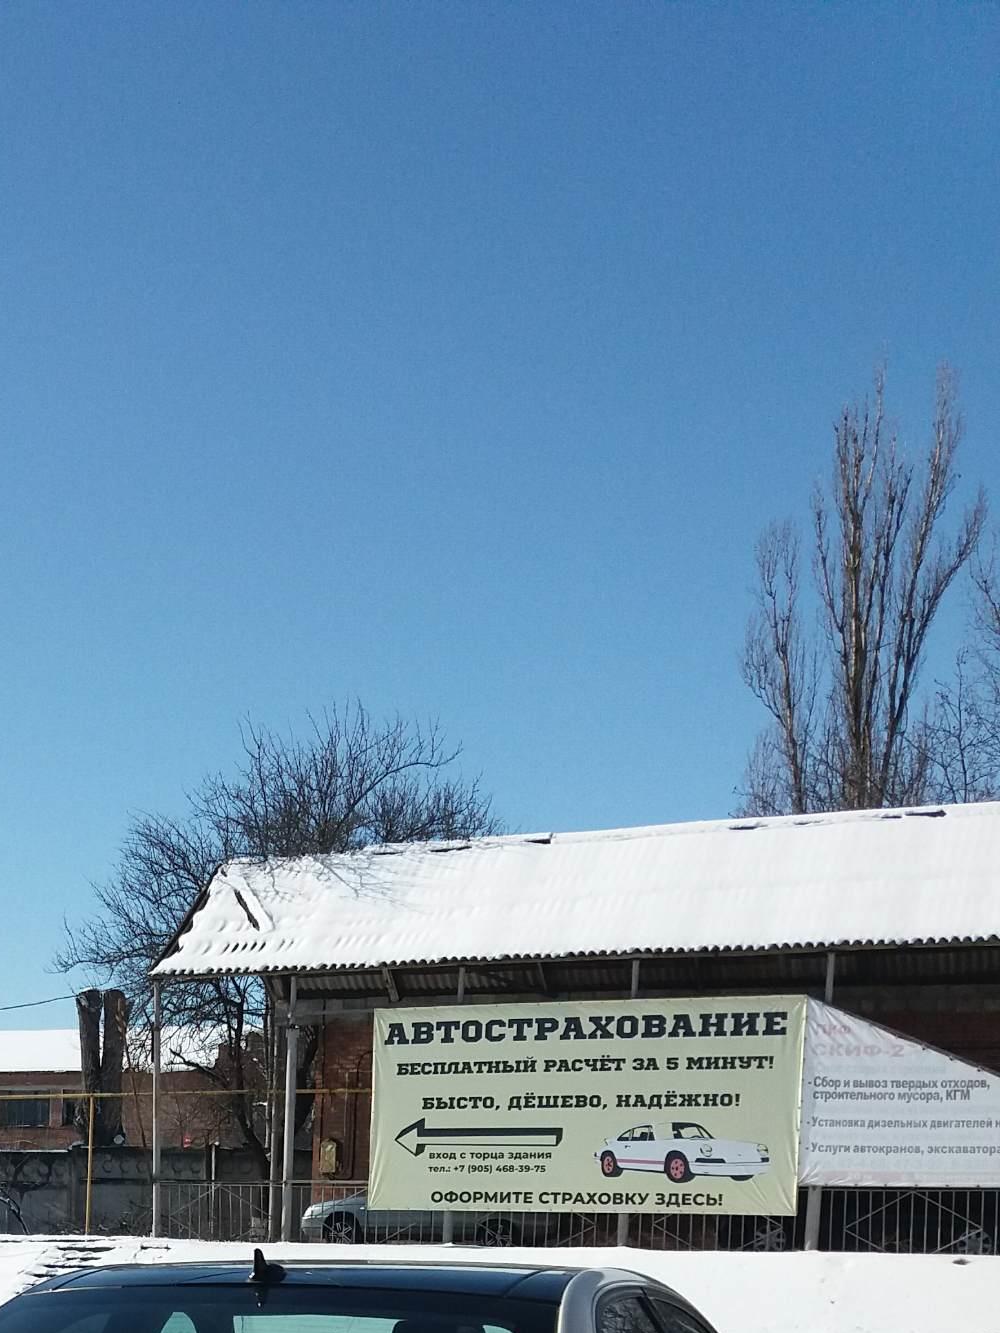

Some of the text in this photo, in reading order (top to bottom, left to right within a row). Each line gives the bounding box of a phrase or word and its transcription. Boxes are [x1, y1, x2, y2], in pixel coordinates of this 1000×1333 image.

[384, 1011, 788, 1046] АВТОСТРАХОВАНИЕ
[397, 1054, 774, 1076] БЕСПЛАТНЫЙ РАСЧЁТ ЗА 5 МИНУТ!
[853, 1080, 888, 1088] вывоз
[890, 1080, 937, 1090] твердых
[941, 1080, 990, 1090] отходов,
[422, 1091, 740, 1111] БЫСТО, ДЁШЕВО, НАДЁЖНО!
[813, 1090, 970, 1103] строительного мусора, КГМ
[867, 1120, 927, 1129] дизельных
[930, 1118, 992, 1129] двигателей
[853, 1145, 925, 1155] автокранов,
[429, 1152, 457, 1161] вход
[470, 1152, 505, 1161] торца
[508, 1152, 552, 1161] здания
[428, 1165, 451, 1173] тел.:
[468, 1164, 493, 1174] (905)
[495, 1165, 546, 1173] 468-39-75
[430, 1190, 723, 1209] ОФОРМИТЕ СТРАХОВКУ ЗДЕСЬ!
